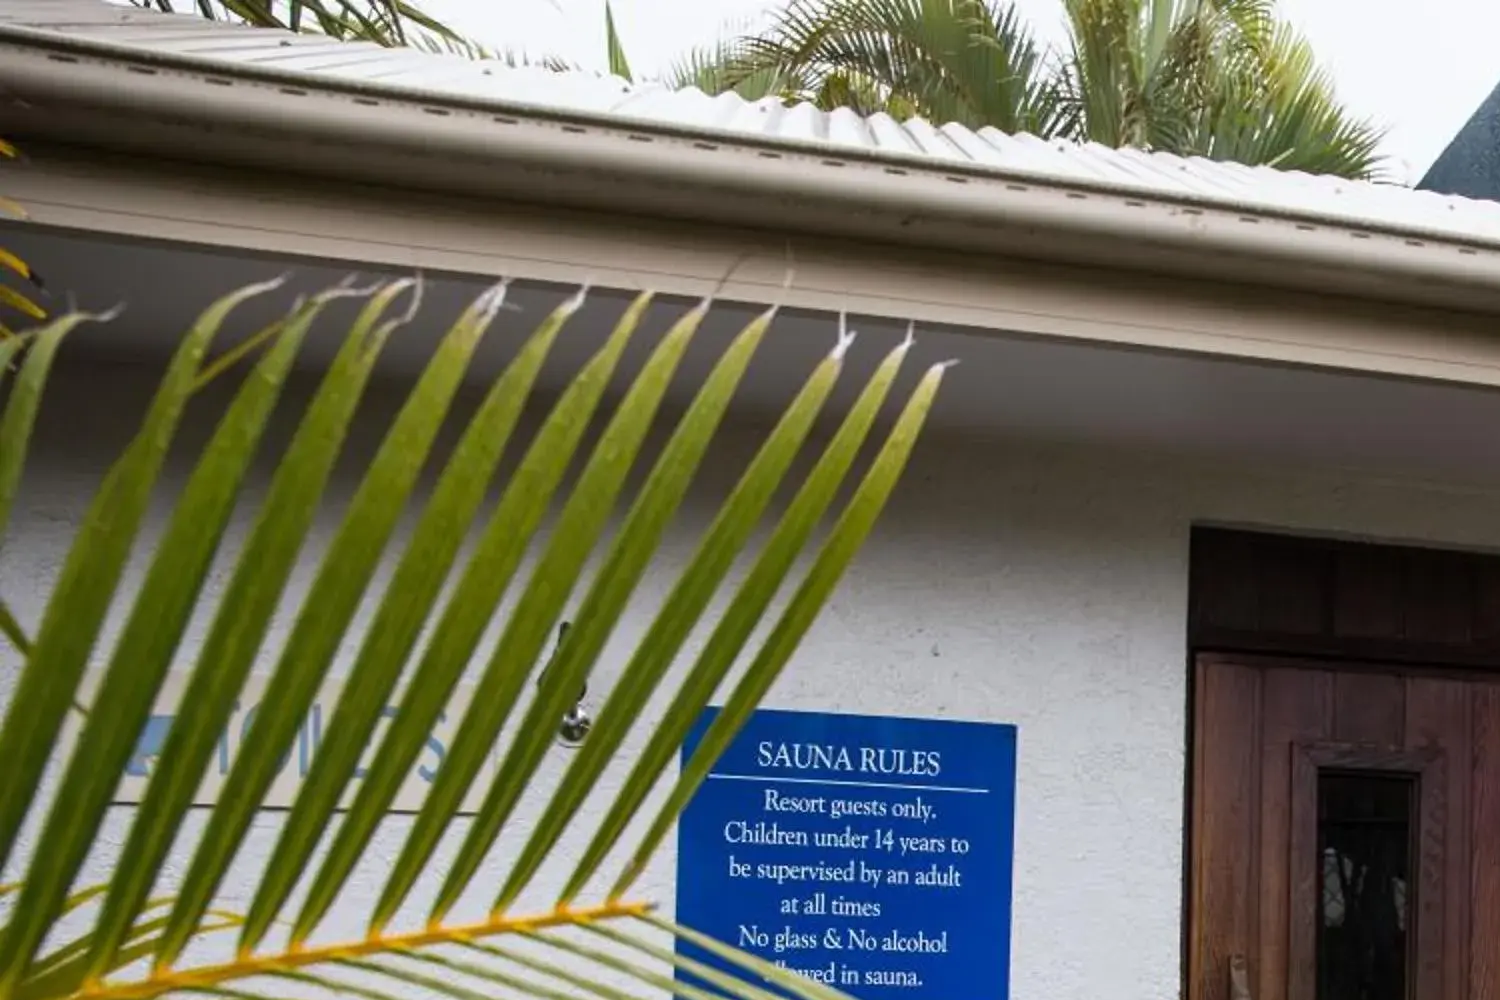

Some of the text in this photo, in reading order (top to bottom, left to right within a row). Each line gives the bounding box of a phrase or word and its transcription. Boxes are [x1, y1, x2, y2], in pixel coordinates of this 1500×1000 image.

[760, 742, 939, 775] SAUNA RULES
[766, 790, 935, 822] Resort guests only.
[725, 822, 968, 854] Children under 14 years to
[730, 856, 960, 887] be supervised by an adult
[782, 894, 880, 916] at all times
[740, 926, 946, 952] No glass & No alcohol
[842, 966, 858, 983] in
[866, 972, 922, 985] sauna.
